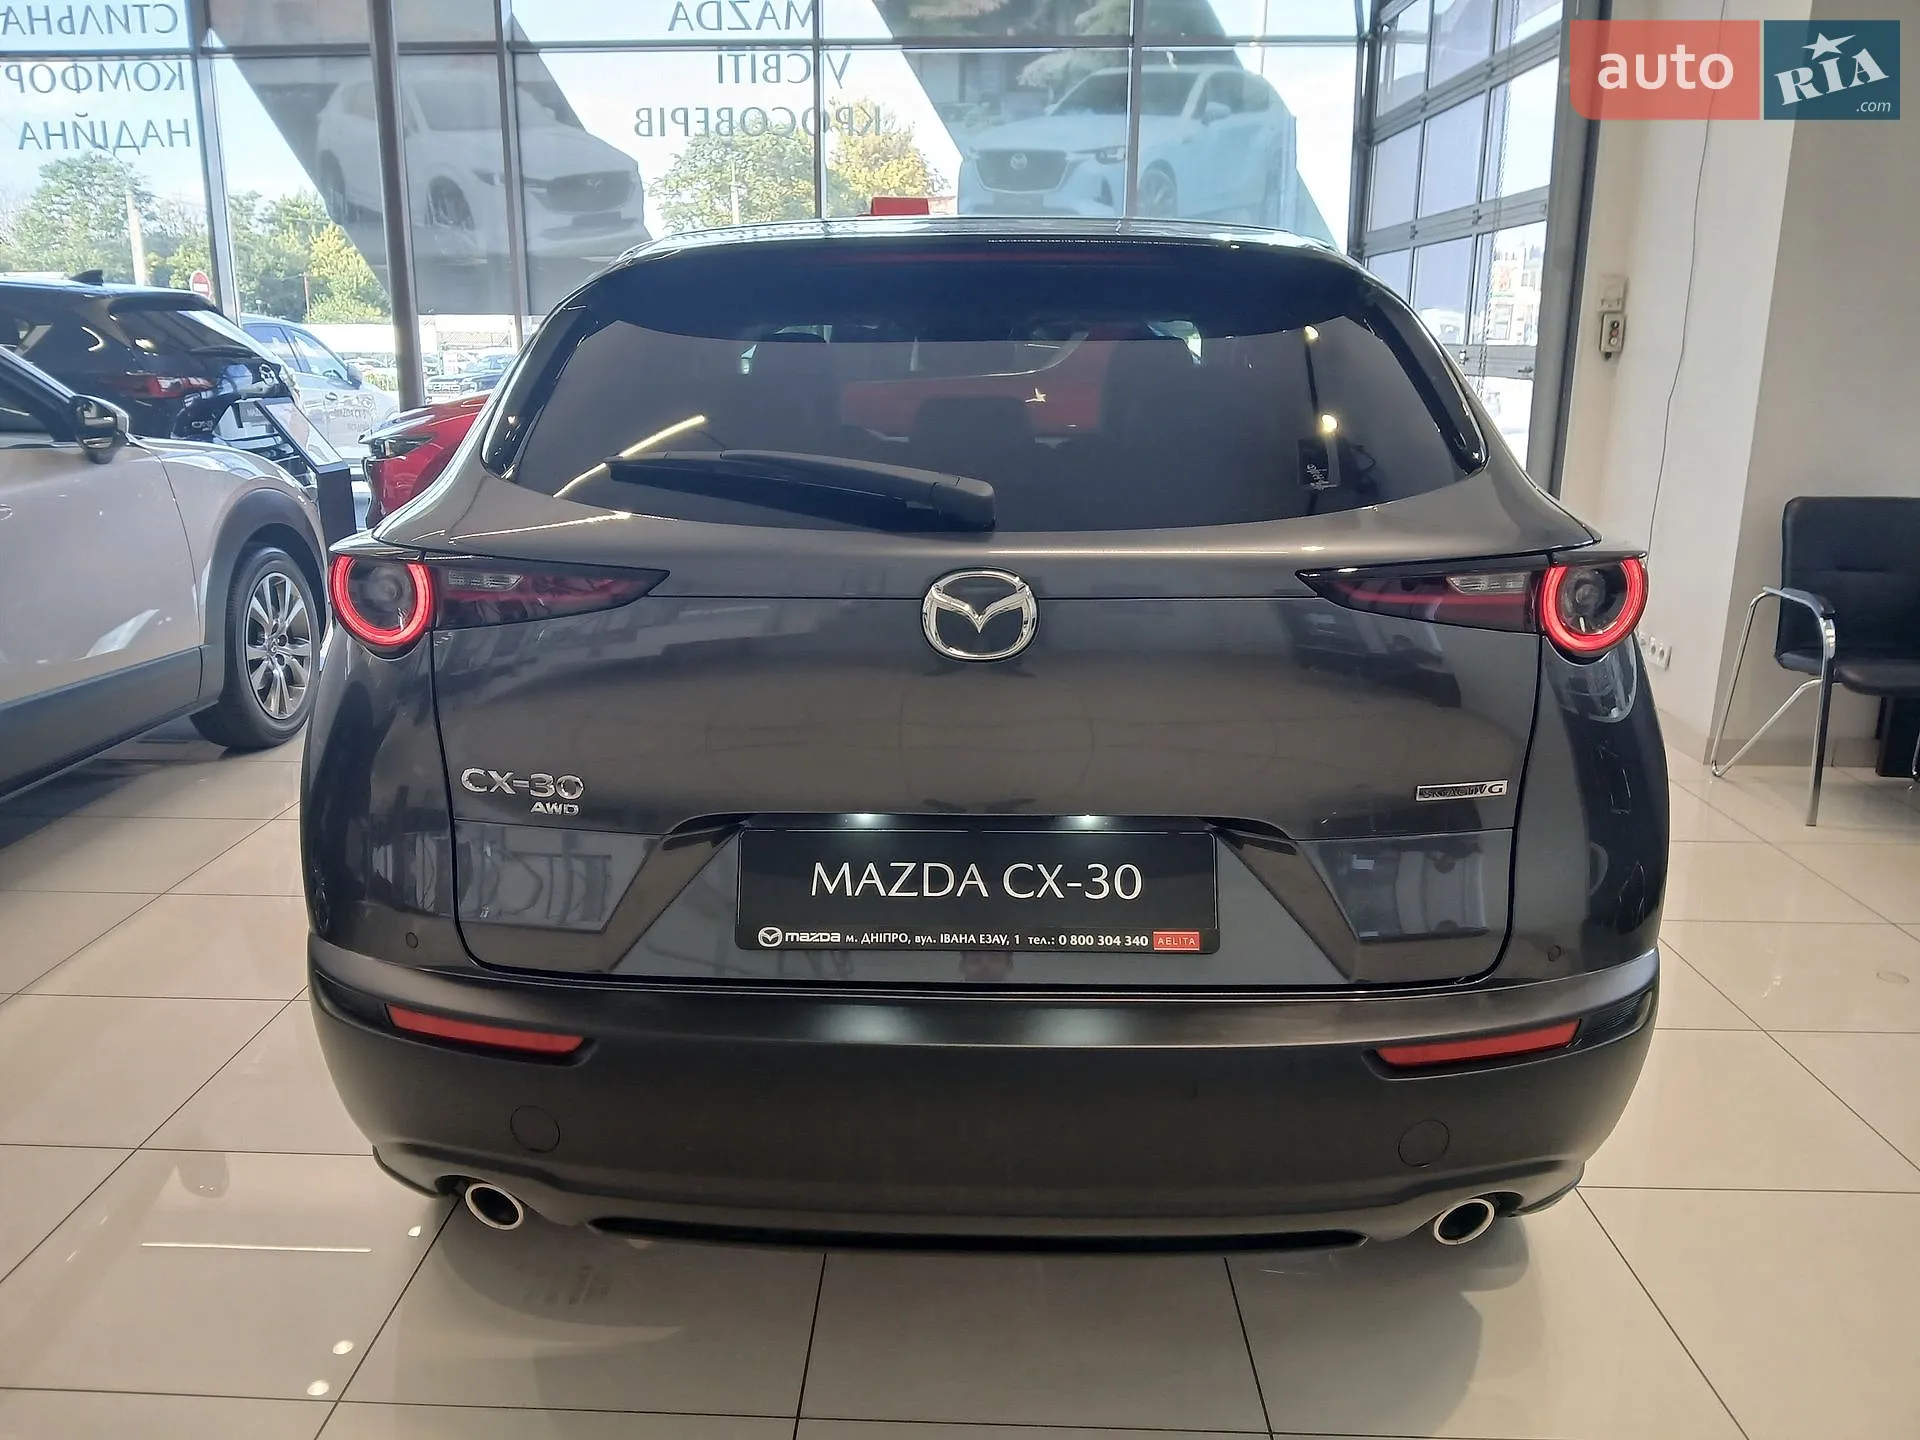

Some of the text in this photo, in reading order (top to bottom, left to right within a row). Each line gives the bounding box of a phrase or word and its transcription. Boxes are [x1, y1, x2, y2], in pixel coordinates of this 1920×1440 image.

[460, 767, 585, 800] CX-30
[530, 801, 580, 816] AWD
[810, 861, 1144, 900] MAZDA CX-30
[784, 932, 841, 943] mazda
[860, 932, 912, 945] ДНІПРО,
[914, 934, 937, 946] вул.
[939, 933, 977, 944] ІВАНА
[979, 934, 1010, 946] ЕЗАУ,
[1014, 934, 1021, 945] 1
[1027, 935, 1055, 945] тел.:
[1058, 934, 1067, 946] 0
[1069, 934, 1094, 946] 800
[1097, 934, 1121, 946] 304
[1124, 935, 1149, 947] 340
[1156, 936, 1197, 946] AELITA
